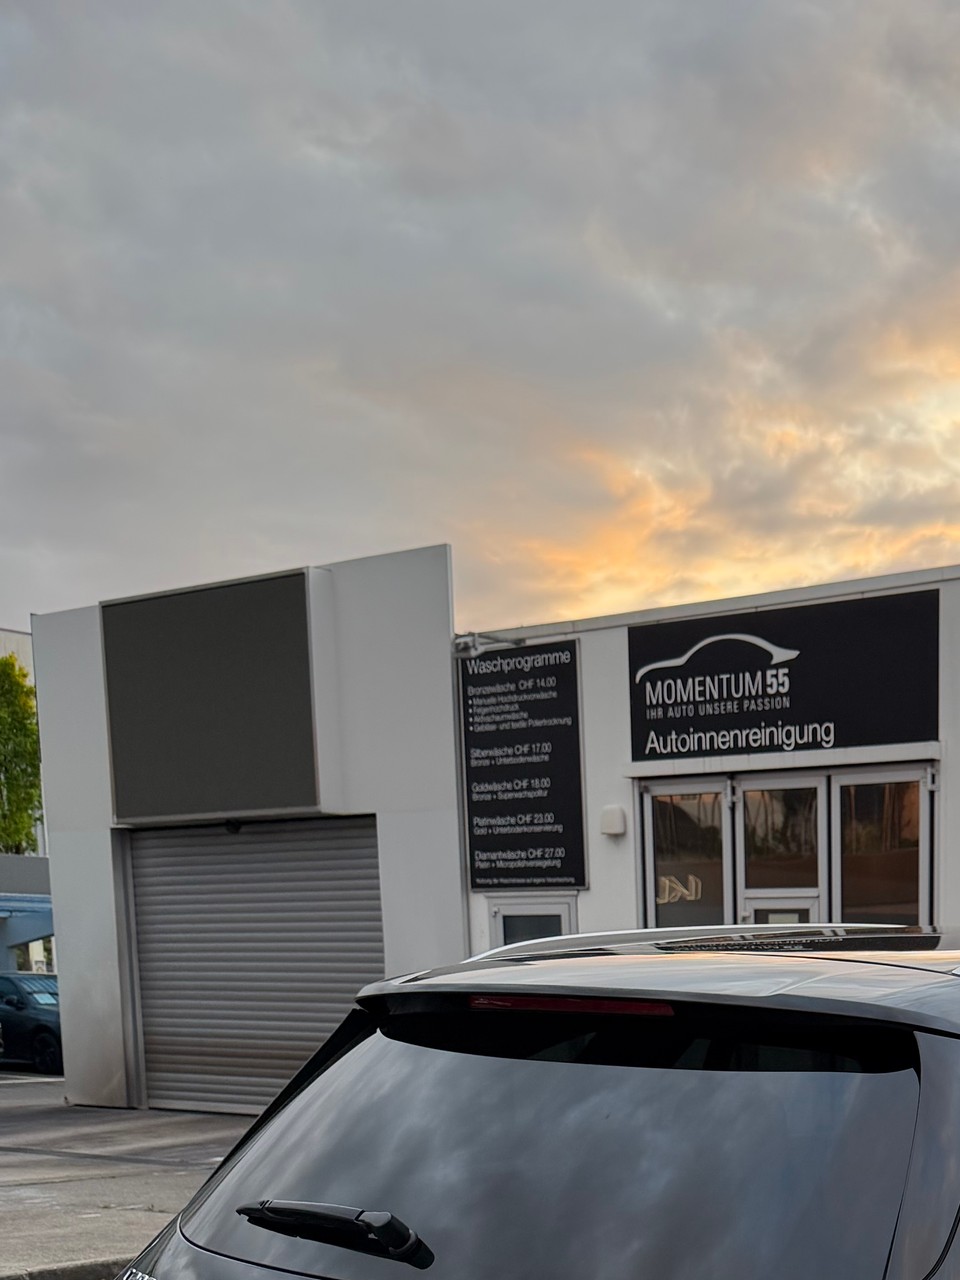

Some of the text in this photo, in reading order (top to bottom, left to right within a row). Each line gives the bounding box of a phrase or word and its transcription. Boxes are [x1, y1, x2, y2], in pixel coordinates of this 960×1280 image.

[466, 650, 571, 675] Waschprogramme
[518, 679, 535, 690] CHF
[536, 676, 557, 688] 14.00
[646, 696, 791, 720] IHR AUTO UNSERE PASSION
[644, 719, 835, 755] Autoinnenreinigung
[514, 743, 531, 755] CHF
[532, 741, 552, 753] 17.00
[513, 779, 530, 790] CHF
[517, 814, 533, 824] CHF
[533, 812, 555, 824] 23.00
[527, 848, 544, 859] CHF
[544, 846, 566, 858] 27.00
